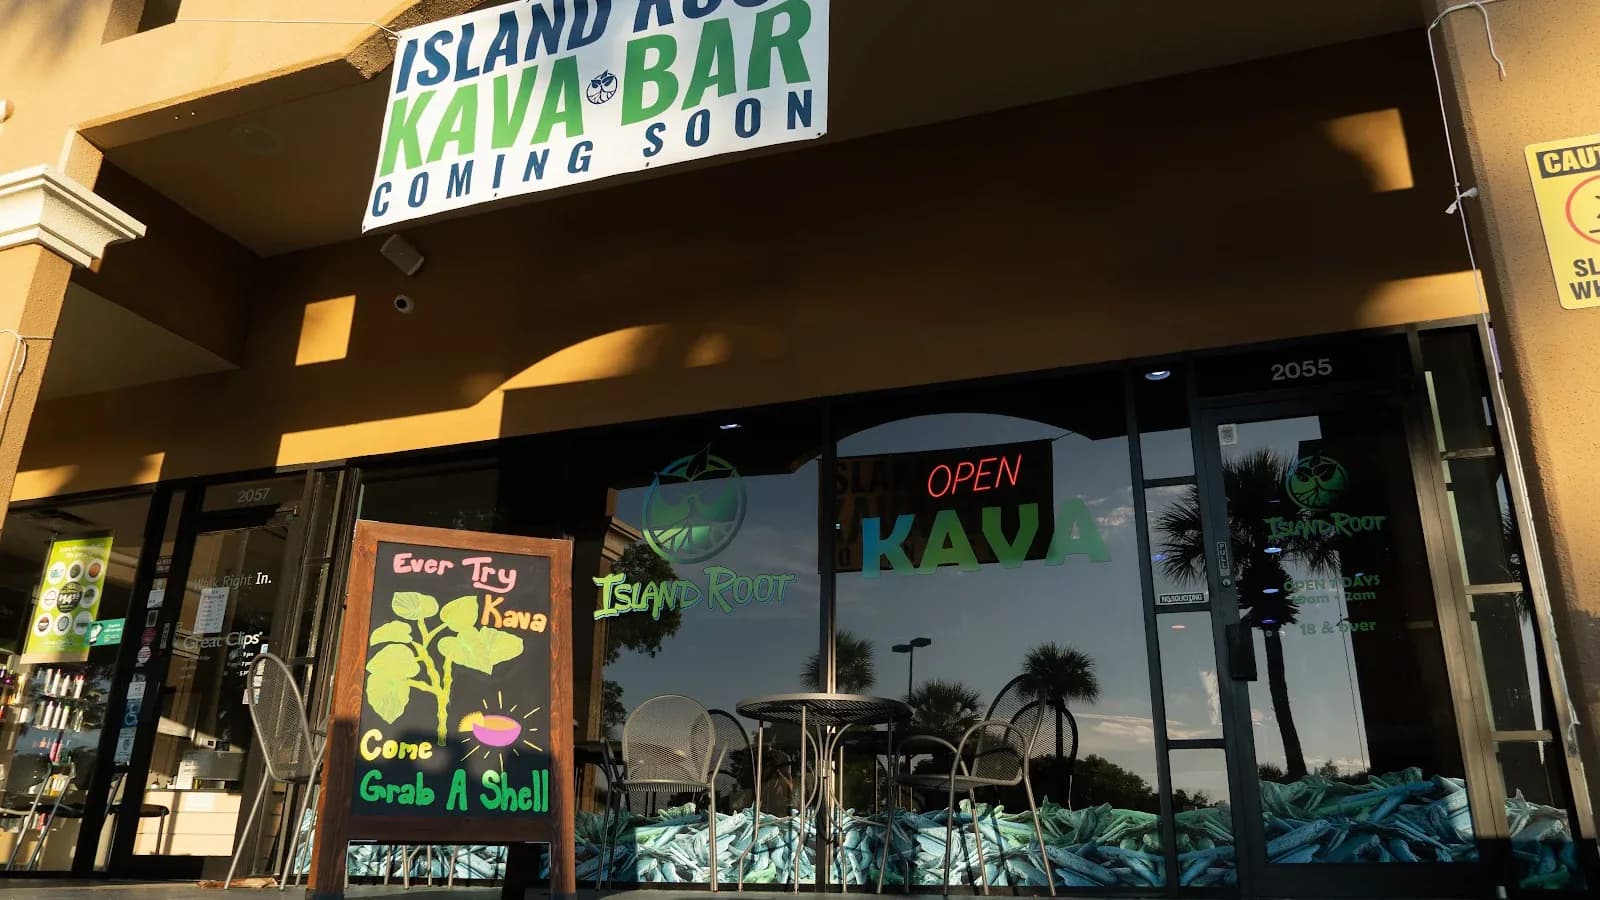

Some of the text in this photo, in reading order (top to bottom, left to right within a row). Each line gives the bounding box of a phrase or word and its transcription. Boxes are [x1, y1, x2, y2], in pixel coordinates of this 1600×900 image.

[396, 0, 612, 93] ISLAND
[379, 0, 812, 177] KAVA BAR
[371, 89, 813, 218] COMING SOON
[1271, 358, 1333, 381] 2055
[927, 453, 1022, 498] OPEN
[238, 488, 271, 503] 2057
[861, 496, 1113, 579] KAVA
[1263, 511, 1387, 541] ISLAND ROOT
[223, 575, 252, 589] Right
[255, 572, 272, 585] In.
[393, 552, 517, 593] Ever Try
[1284, 579, 1326, 591] OPEN
[1342, 574, 1380, 588] DAYS
[593, 566, 797, 621] ISLAND ROOT
[481, 594, 547, 632] Kava
[1300, 621, 1377, 635] 18 & over
[184, 635, 222, 649] Great
[360, 729, 433, 761] Come
[360, 769, 549, 812] Grab A Shell
